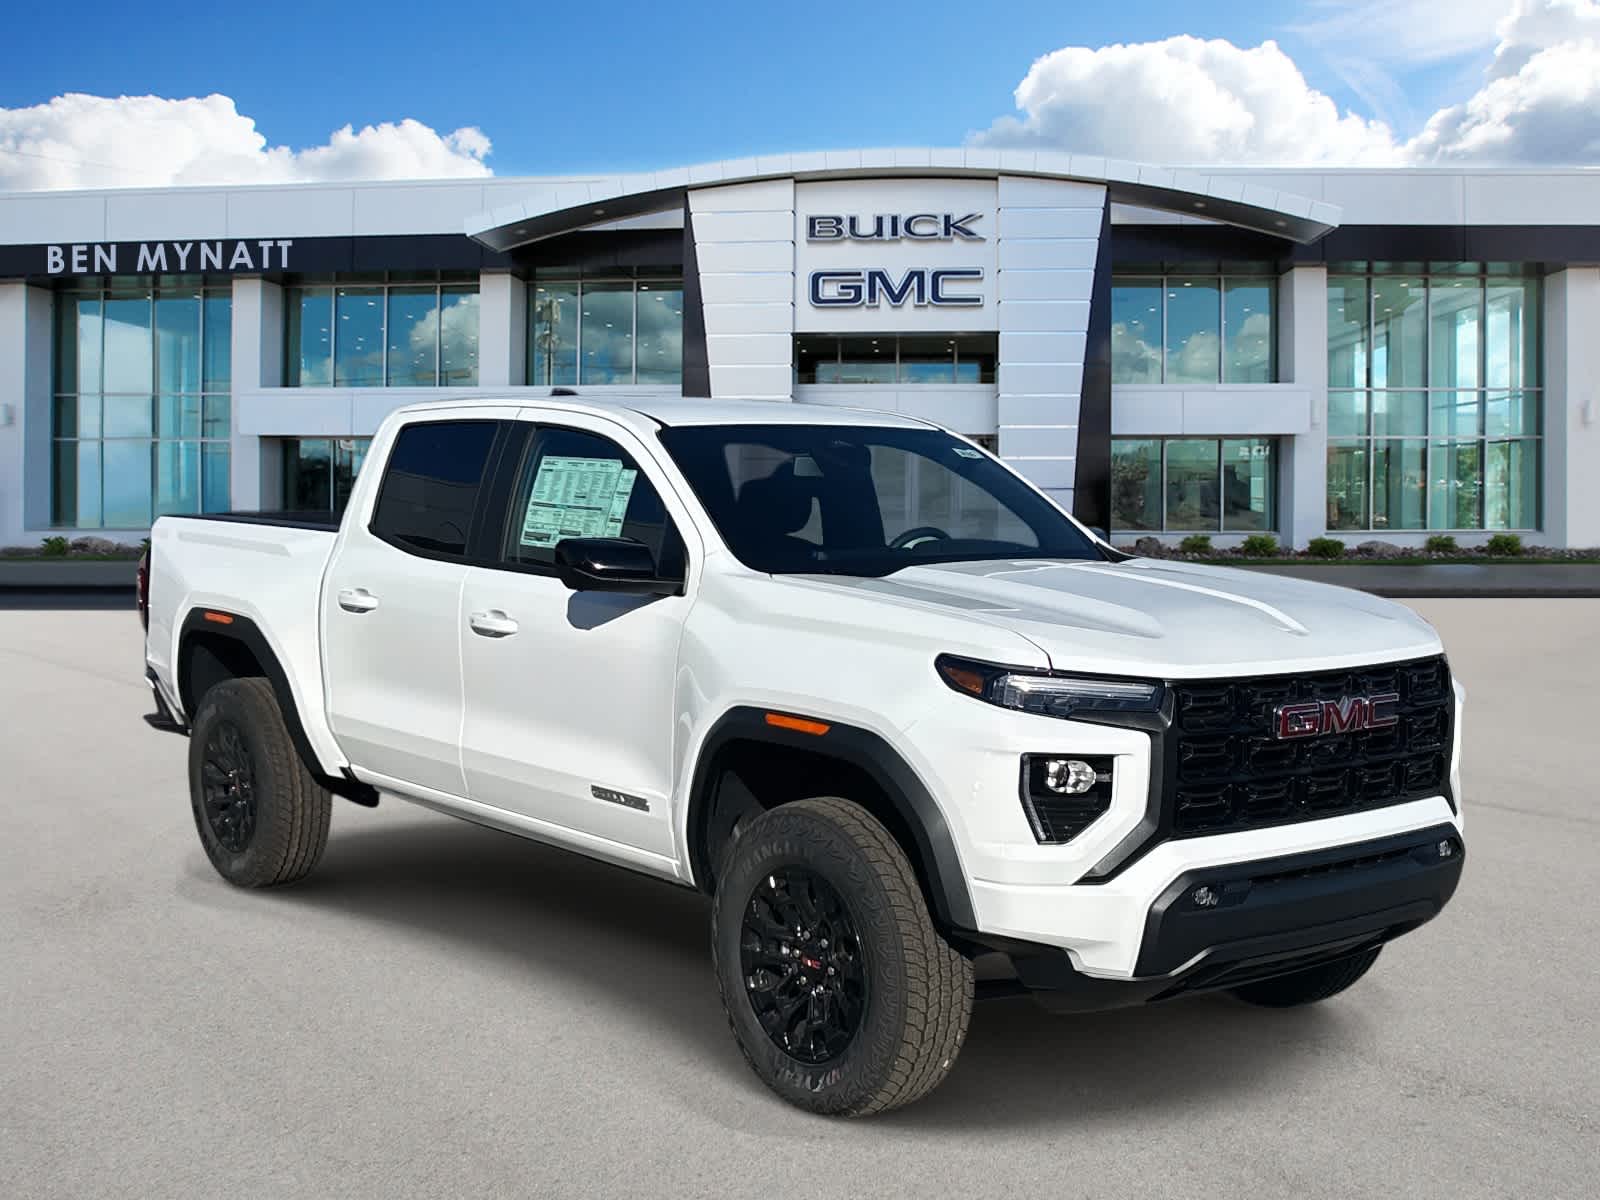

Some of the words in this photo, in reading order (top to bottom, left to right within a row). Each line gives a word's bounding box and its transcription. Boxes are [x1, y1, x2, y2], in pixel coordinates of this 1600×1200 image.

[806, 213, 986, 242] BUICK
[47, 244, 117, 274] BEN
[136, 240, 293, 272] MYNATT
[809, 267, 984, 308] GMC
[1275, 692, 1400, 740] GMC
